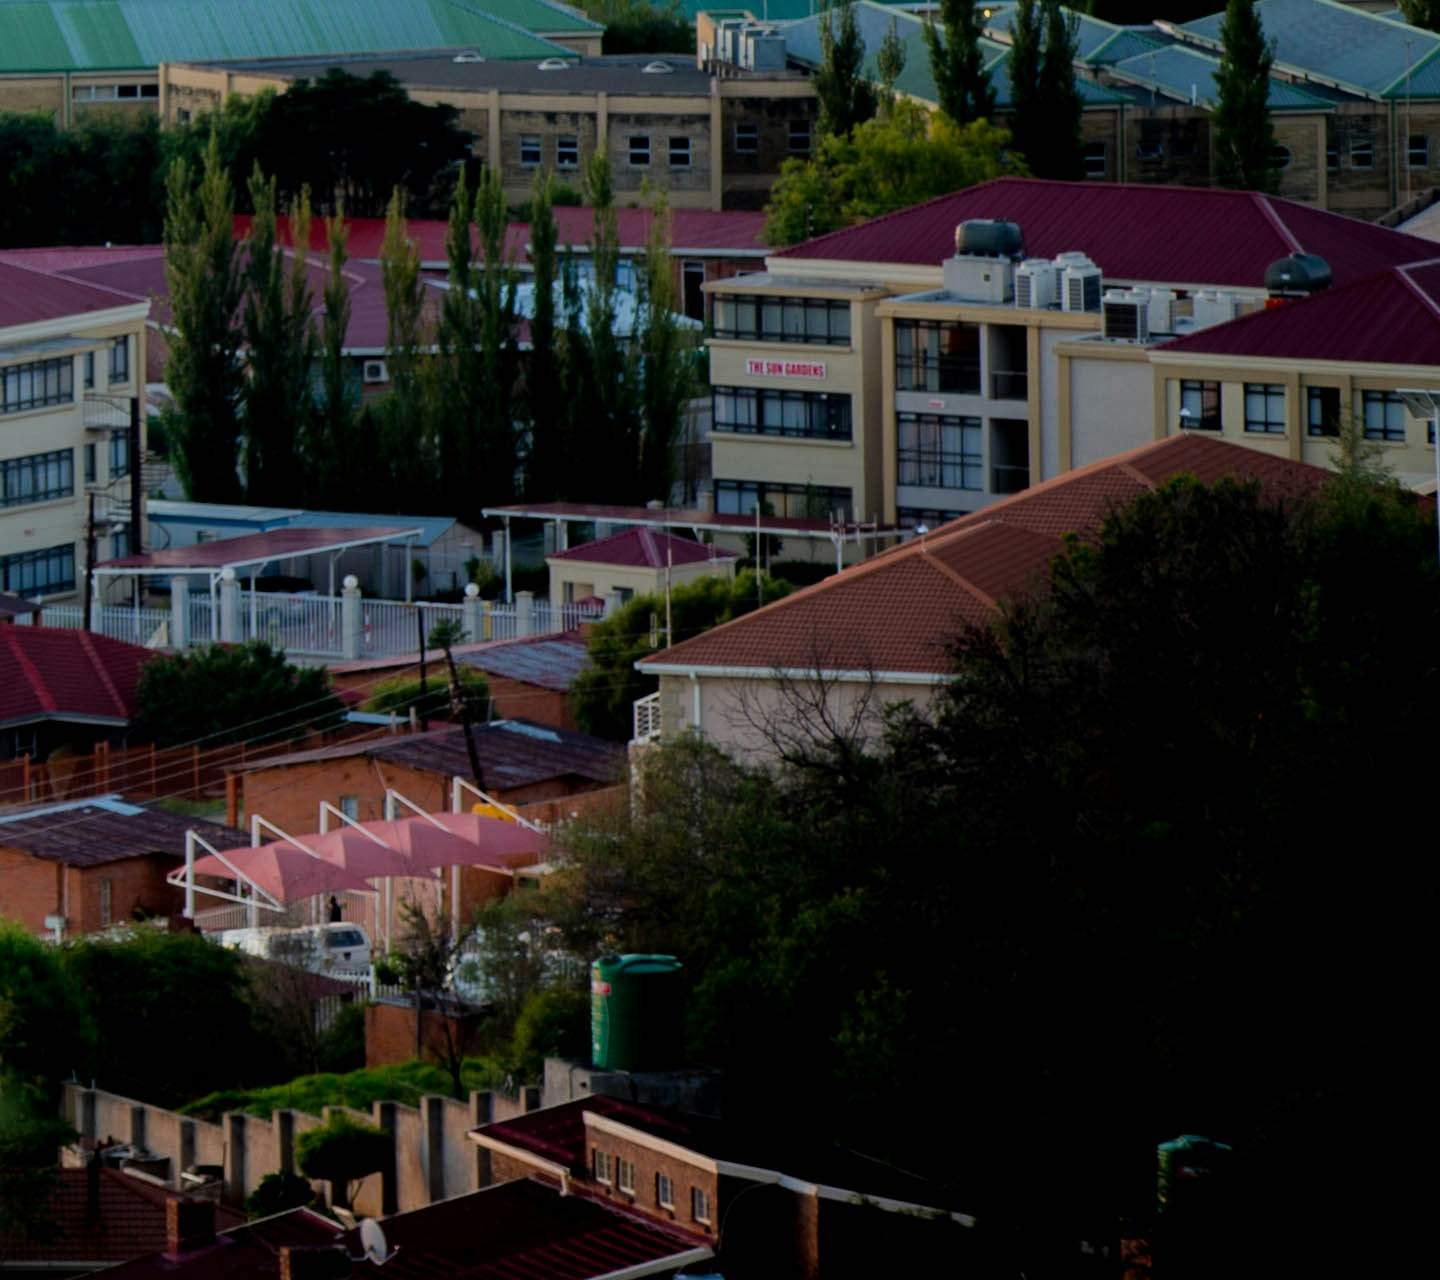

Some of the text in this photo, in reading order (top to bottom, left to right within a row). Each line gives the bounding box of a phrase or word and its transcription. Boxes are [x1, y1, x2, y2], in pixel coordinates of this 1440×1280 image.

[749, 361, 823, 377] THE SUN GARDENS
